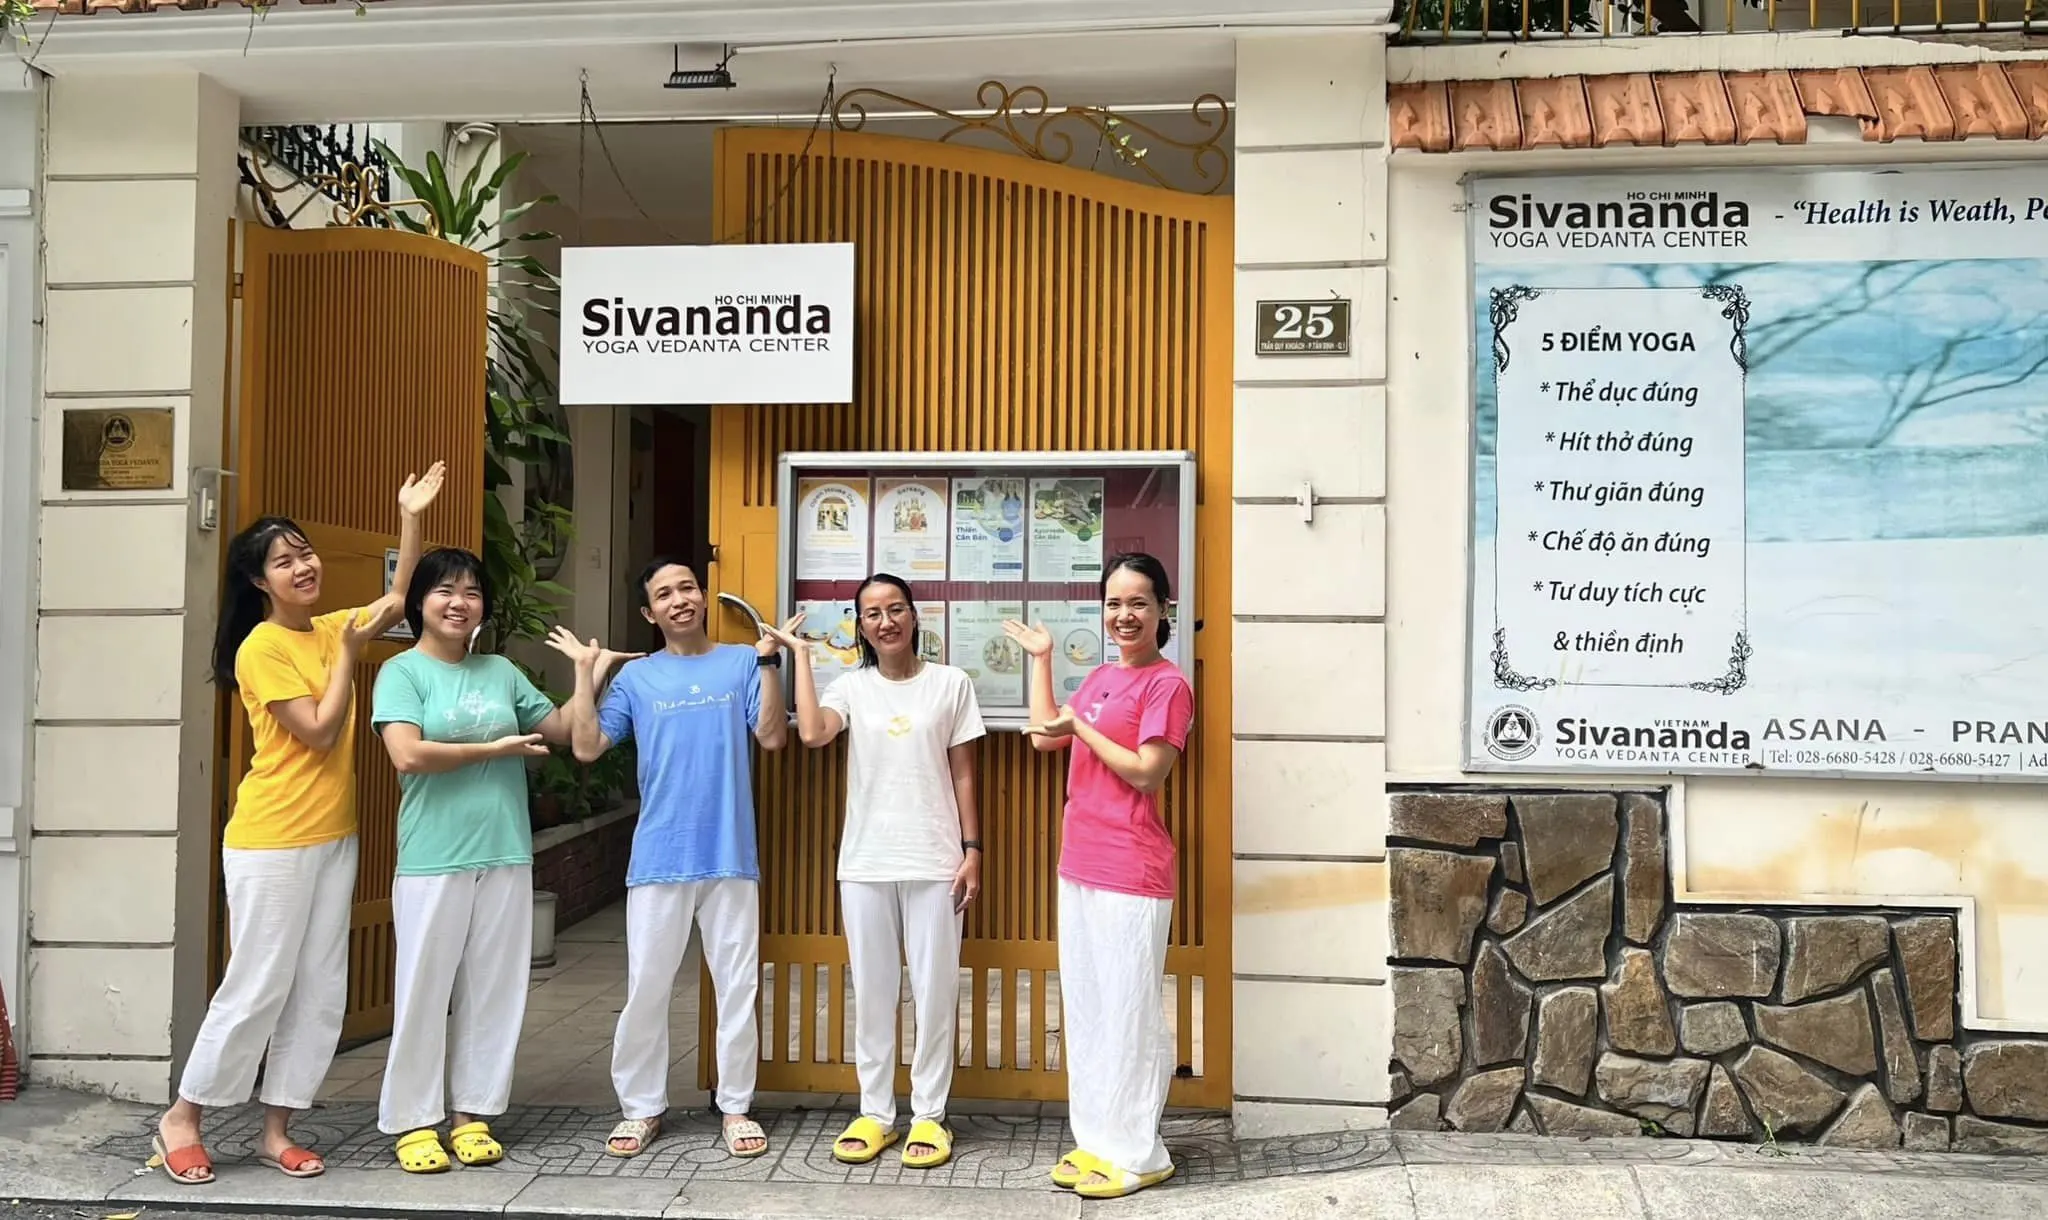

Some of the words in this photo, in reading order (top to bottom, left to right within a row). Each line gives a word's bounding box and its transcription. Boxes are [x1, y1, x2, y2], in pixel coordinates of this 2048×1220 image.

[1627, 191, 1645, 200] HO
[1650, 191, 1671, 200] CHI
[1675, 191, 1707, 201] MINH
[1489, 192, 1750, 229] Sivananda
[1899, 200, 1920, 223] is
[1929, 197, 2016, 224] Weath,
[1490, 231, 1549, 248] YOGA
[1556, 231, 1656, 248] VEDANTA
[1663, 230, 1749, 248] CENTER
[714, 295, 732, 305] HO
[736, 294, 758, 305] CHI
[761, 294, 793, 305] MINH
[582, 294, 831, 337] Sivananda
[1272, 305, 1335, 339] 25
[583, 340, 640, 353] YOGA
[647, 339, 742, 353] VEDANTA
[749, 337, 830, 353] CENTER
[1542, 333, 1554, 351] 5
[1560, 325, 1622, 352] ĐIỂM
[1628, 332, 1696, 352] YOGA
[1556, 378, 1596, 402] Thể
[1599, 381, 1638, 407] dục
[1642, 381, 1698, 407] đúng
[1560, 431, 1592, 451] Hít
[1596, 430, 1634, 451] thở
[1637, 431, 1693, 458] đúng
[1550, 480, 1592, 501] Thư
[1595, 482, 1642, 506] giãn
[1648, 481, 1704, 507] đúng
[1543, 529, 1587, 551] Chế
[1588, 530, 1616, 556] độ
[1621, 531, 1648, 552] ăn
[1654, 531, 1711, 558] đúng
[1549, 581, 1576, 601] Tư
[1578, 581, 1620, 607] duy
[1624, 582, 1663, 602] tích
[1669, 586, 1706, 609] cực
[1553, 631, 1570, 651] &
[1575, 630, 1630, 652] thiền
[1635, 632, 1684, 659] định
[1555, 717, 1751, 751] Sivananda
[1654, 719, 1710, 728] VIETNAM
[1762, 718, 1888, 742] ASANA
[1554, 748, 1599, 760] YOGA
[1606, 749, 1681, 763] VEDANTA
[1687, 751, 1751, 765] CENTER
[1769, 750, 1793, 764] Tel:
[1796, 750, 1897, 764] 028-6680-5428
[1909, 751, 2011, 767] 028-6680-5427
